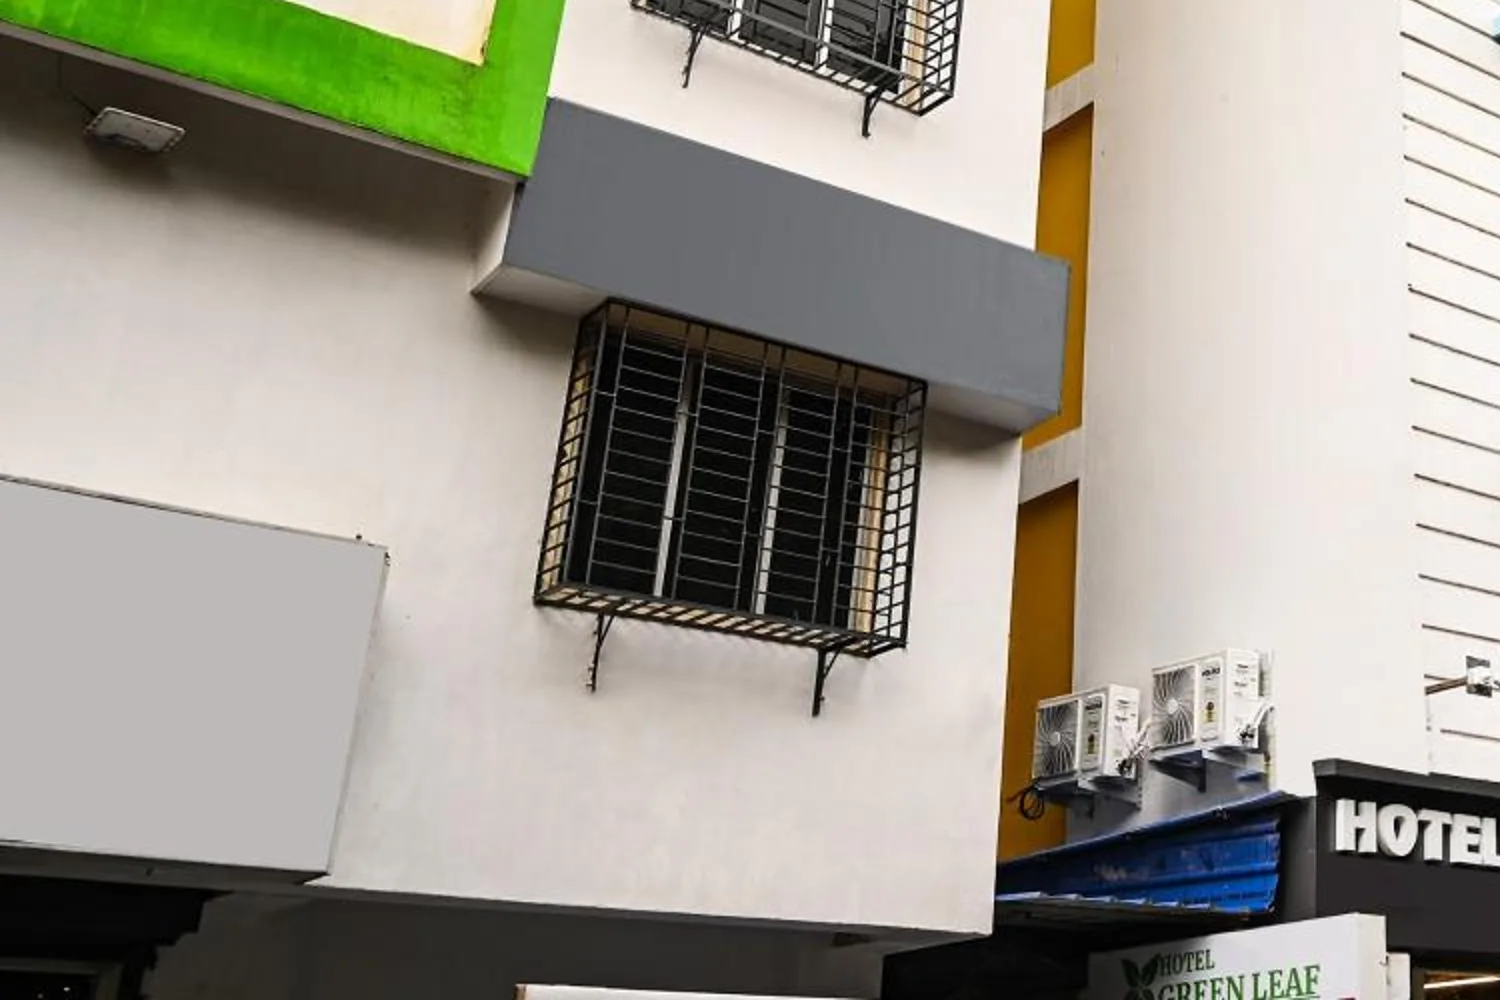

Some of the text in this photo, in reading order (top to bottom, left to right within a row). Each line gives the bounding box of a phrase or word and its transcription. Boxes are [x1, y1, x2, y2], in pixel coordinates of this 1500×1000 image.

[1159, 949, 1215, 977] HOTEL
[1158, 964, 1321, 1000] GREEN LEAF
